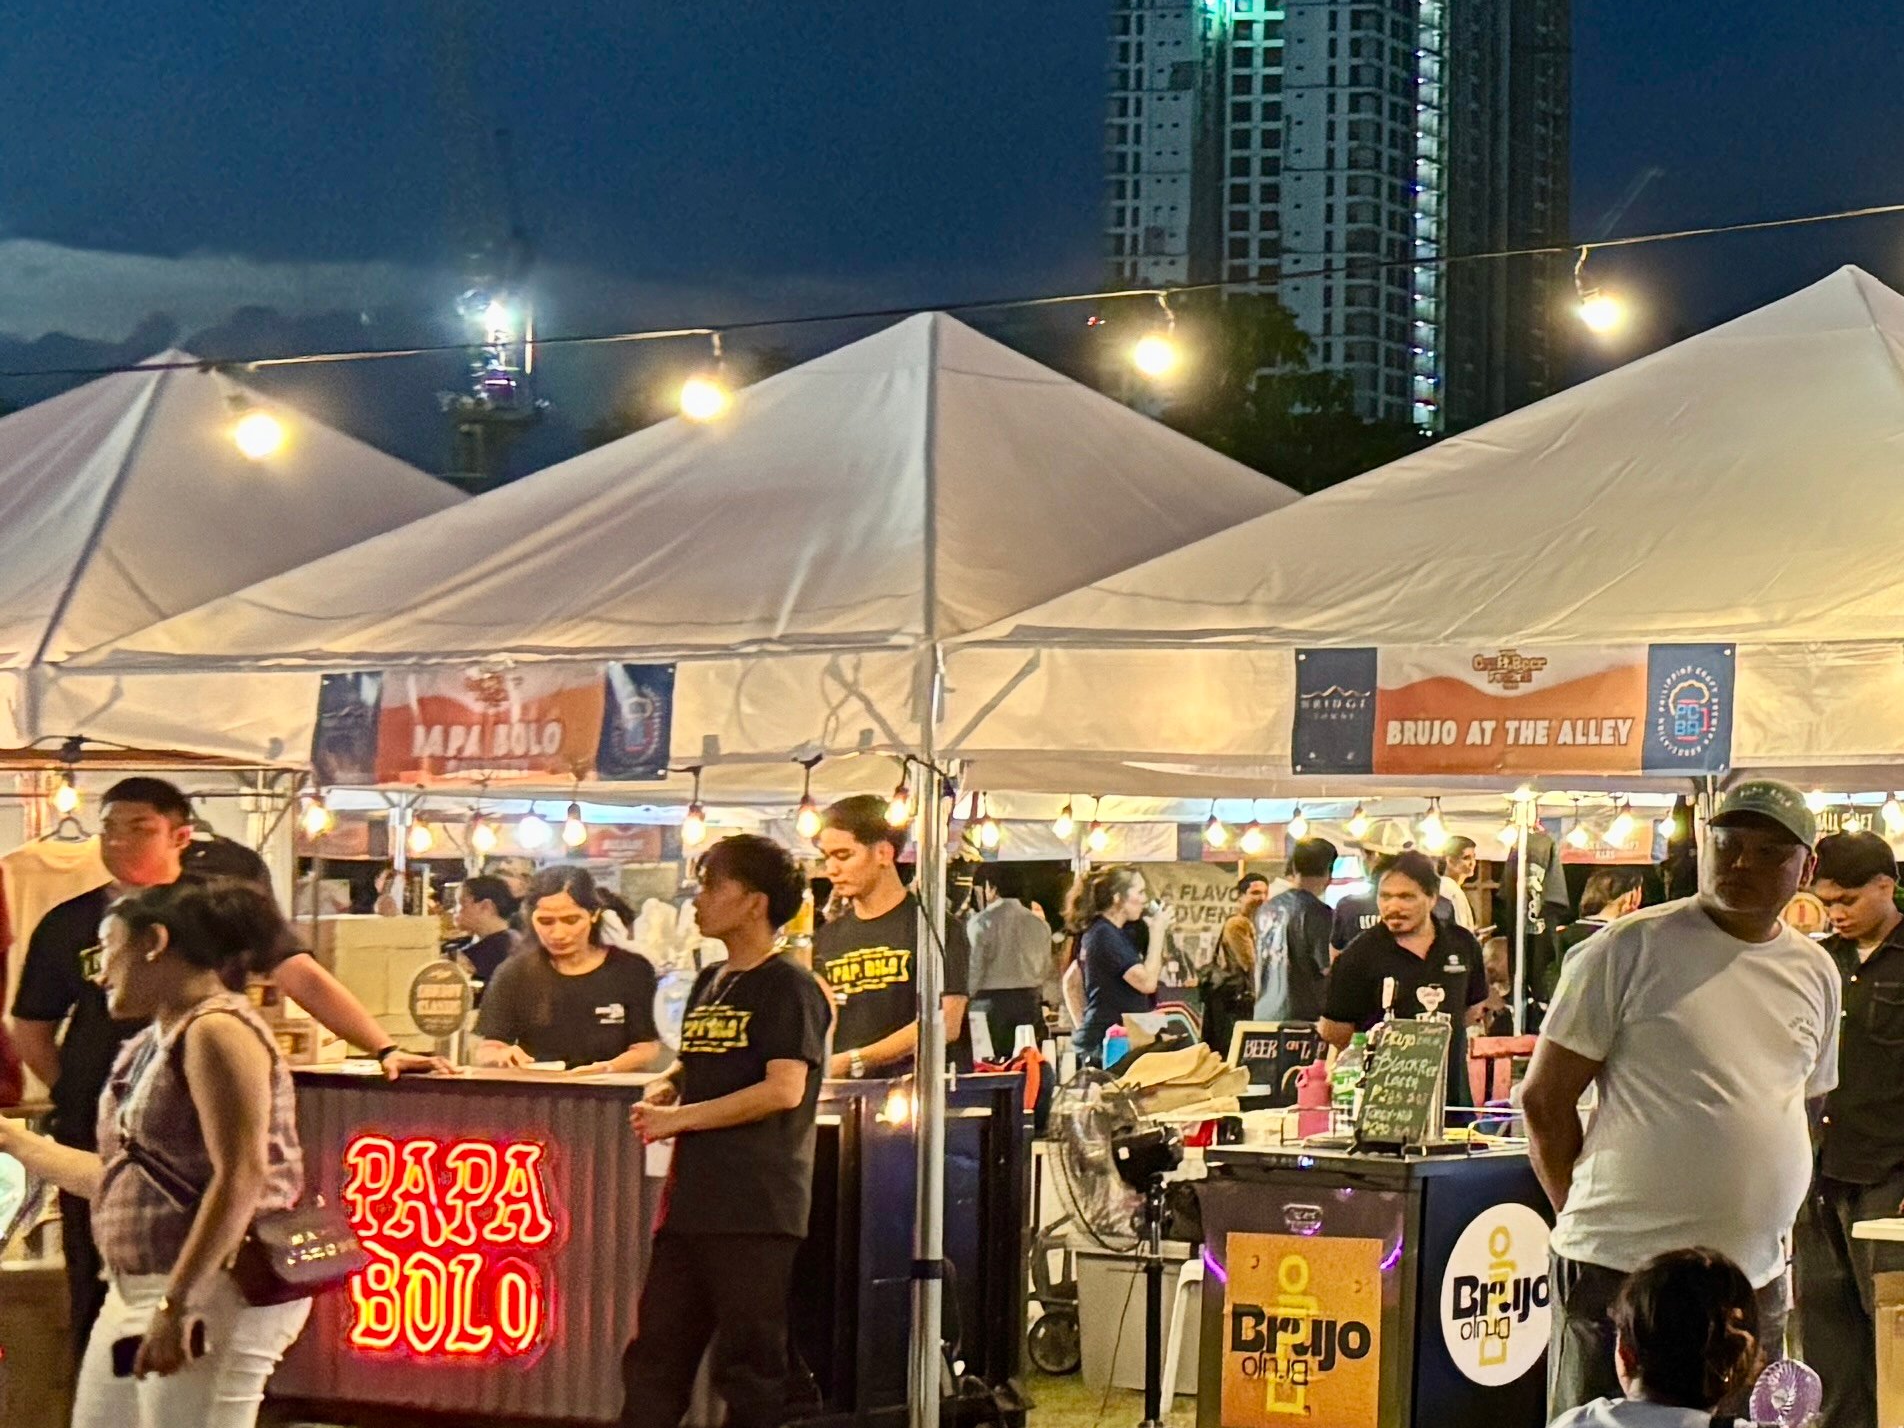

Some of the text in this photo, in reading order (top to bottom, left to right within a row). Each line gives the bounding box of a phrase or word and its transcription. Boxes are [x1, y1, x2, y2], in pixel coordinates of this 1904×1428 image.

[1386, 718, 1634, 746] BRUJO AT THE ALLEY
[1179, 883, 1240, 902] FLAVO
[1243, 1039, 1278, 1059] BEER
[345, 1135, 553, 1248] PAPA
[350, 1239, 544, 1355] BOLO
[1452, 1275, 1551, 1323] Brujo
[1231, 1302, 1372, 1373] Brujo
